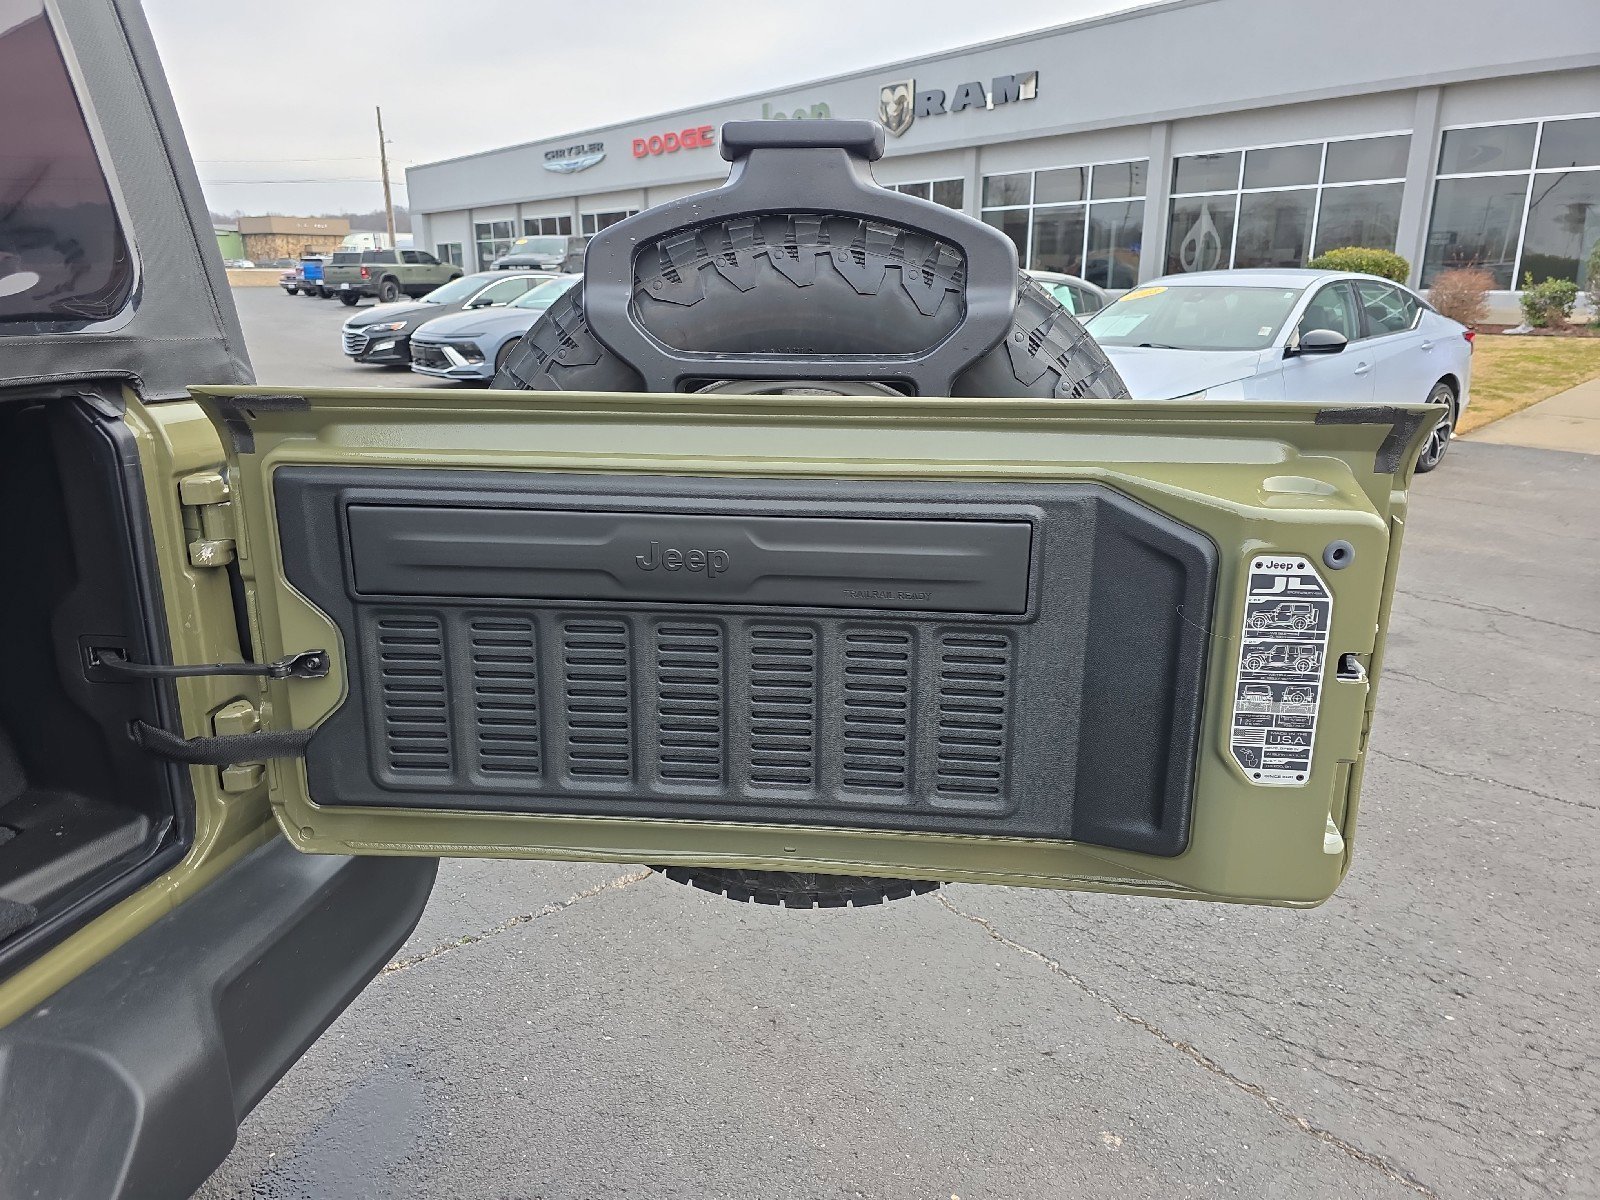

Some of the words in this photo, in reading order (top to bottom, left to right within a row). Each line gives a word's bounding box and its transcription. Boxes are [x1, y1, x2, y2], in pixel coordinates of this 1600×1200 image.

[915, 70, 1039, 117] RAM
[632, 124, 715, 158] DODGE
[544, 142, 604, 161] CHRYSLER
[636, 541, 730, 578] Jeep
[1265, 560, 1293, 571] Jeep
[1252, 576, 1320, 594] JL
[843, 589, 895, 600] TRAILRAIL
[897, 591, 932, 601] READY
[1269, 735, 1306, 745] U.S.A.
